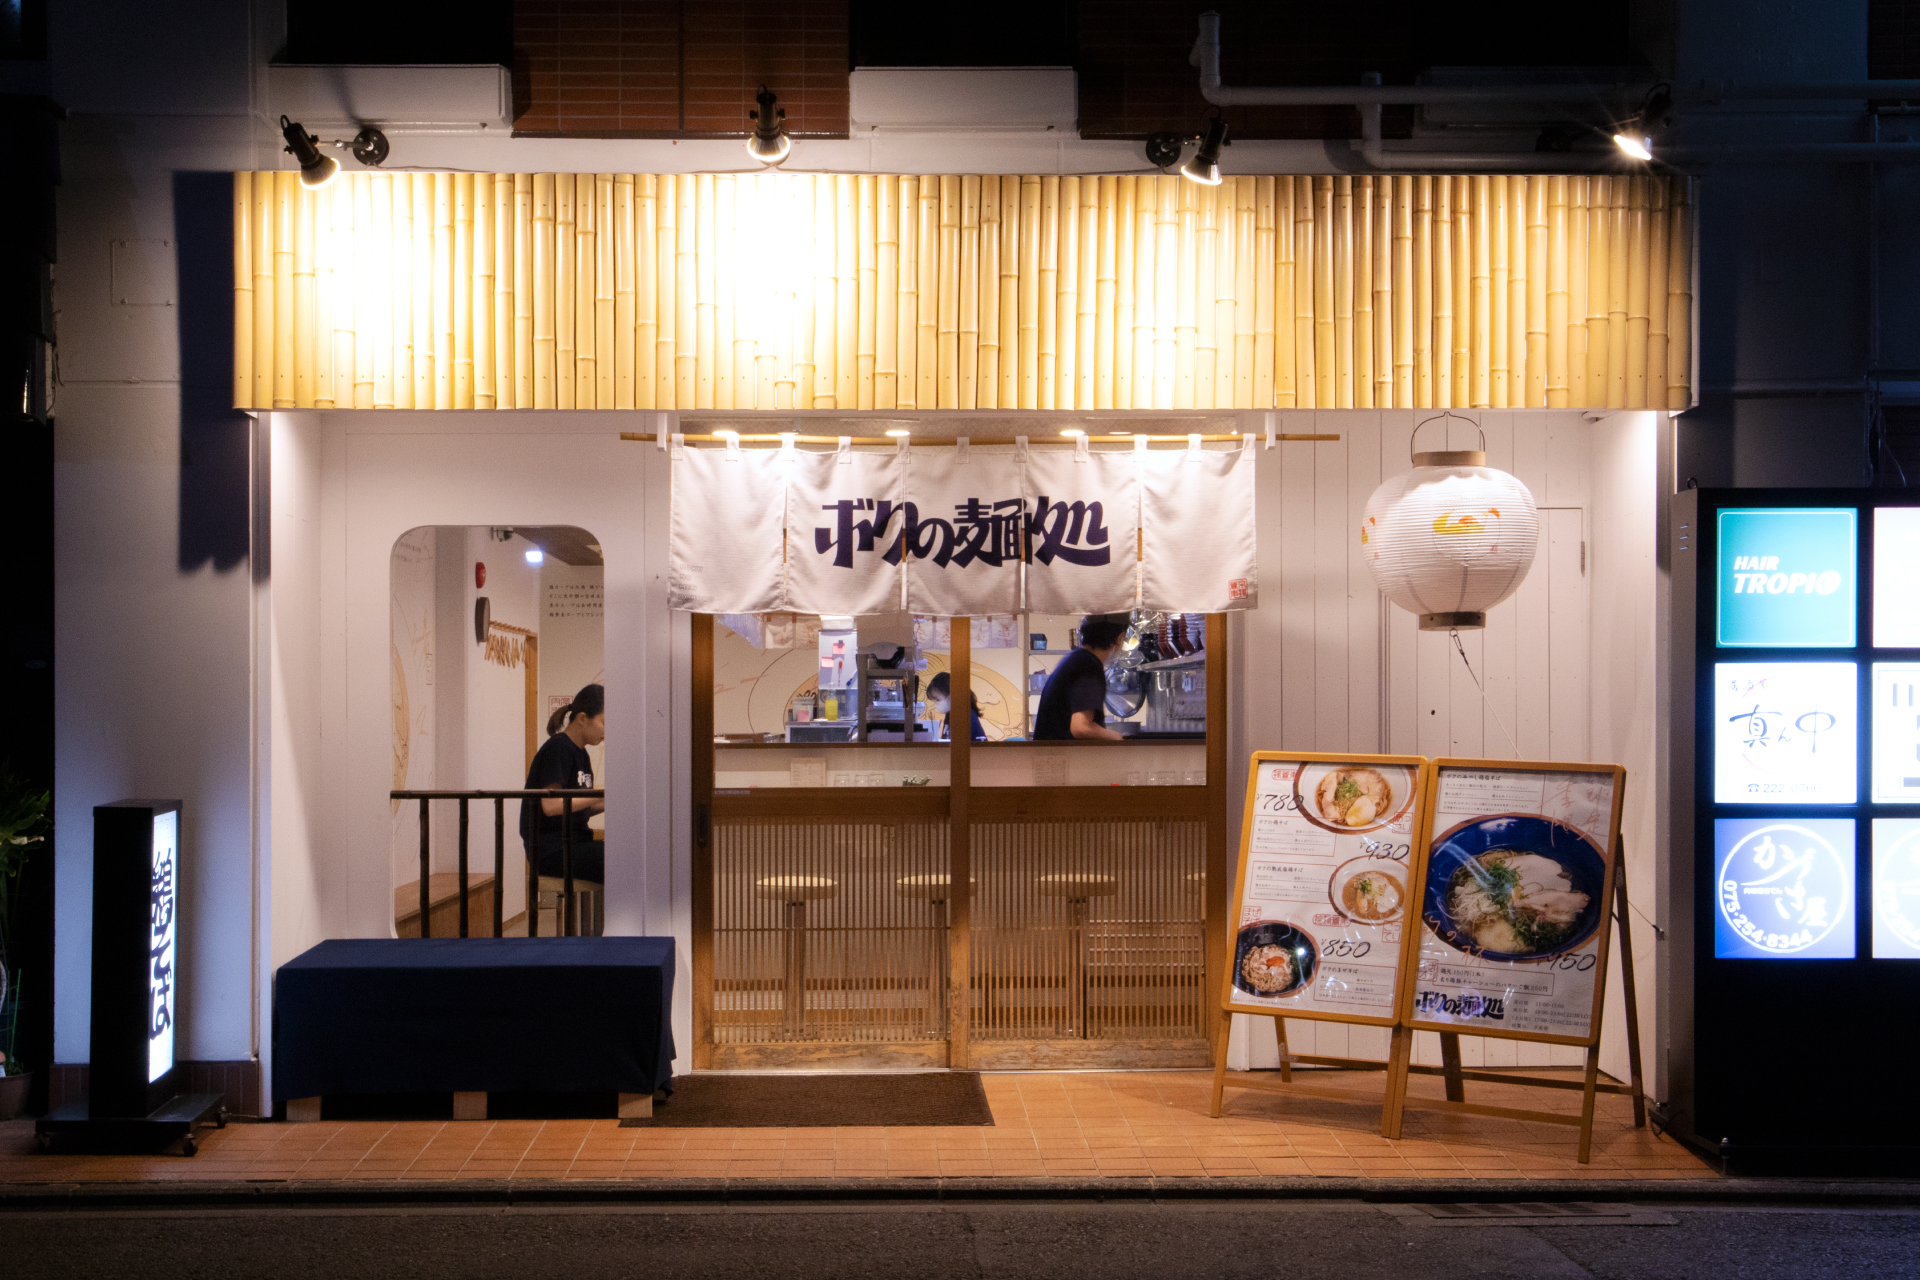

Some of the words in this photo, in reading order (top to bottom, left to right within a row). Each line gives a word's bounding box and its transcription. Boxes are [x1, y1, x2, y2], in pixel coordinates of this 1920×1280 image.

[1733, 556, 1780, 570] HAIR
[1729, 704, 1837, 754] 真ん中
